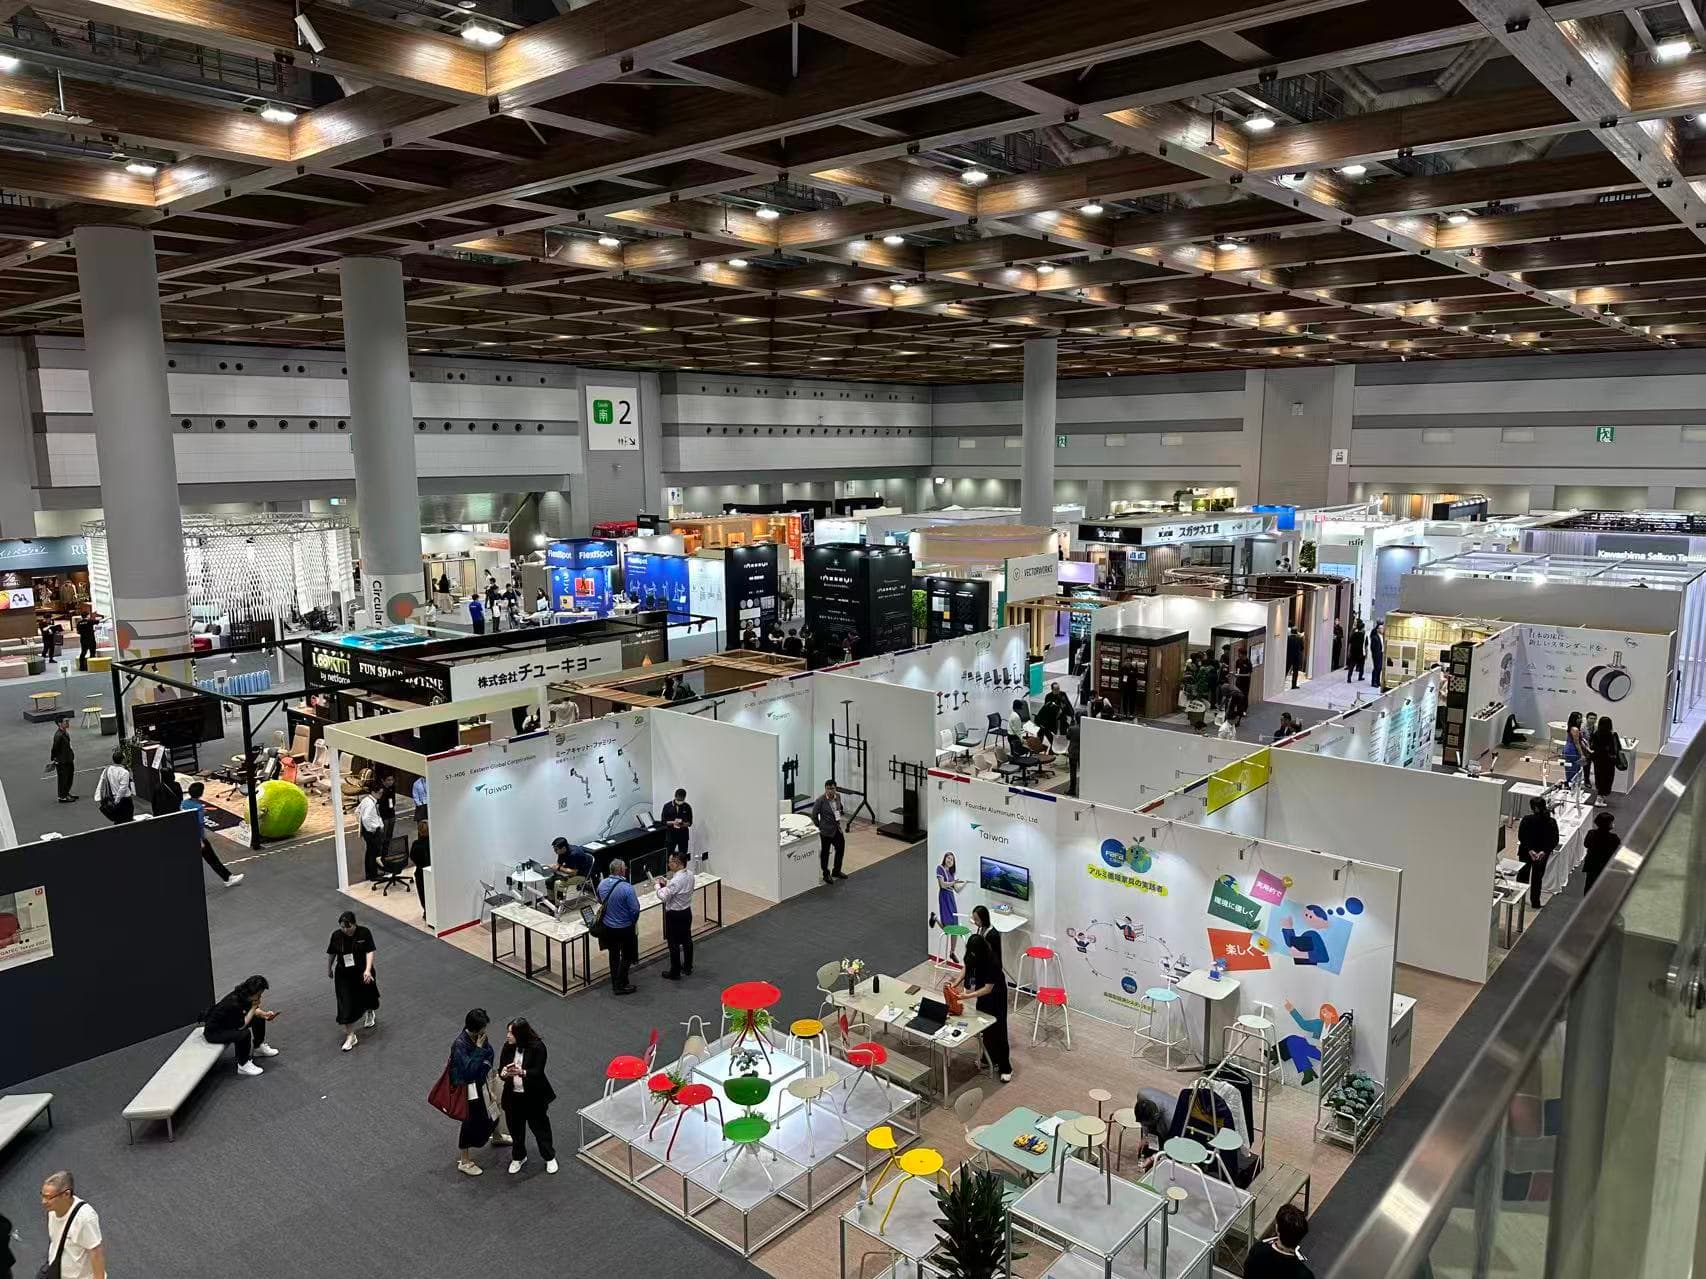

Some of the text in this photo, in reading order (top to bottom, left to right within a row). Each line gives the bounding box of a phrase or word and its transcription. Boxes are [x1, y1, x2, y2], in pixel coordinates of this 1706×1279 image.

[619, 400, 632, 425] 2
[578, 549, 614, 560] FlexiSpot
[1023, 564, 1053, 577] VECTORWORKS
[372, 580, 384, 626] Circular
[320, 671, 327, 681] by
[358, 662, 376, 676] FUN
[477, 657, 602, 689] 株式会社チューキョー
[469, 766, 490, 775] Eastern
[490, 761, 507, 770] Global
[507, 754, 537, 768] Corporation
[484, 783, 513, 796] Taiwan
[965, 801, 987, 812] Founder
[987, 806, 1016, 818] Aluminum
[979, 829, 1009, 845] Taiwan
[792, 850, 815, 862] Taiwan
[1213, 895, 1255, 918] 環境に優しく
[1225, 943, 1255, 957] 楽しく
